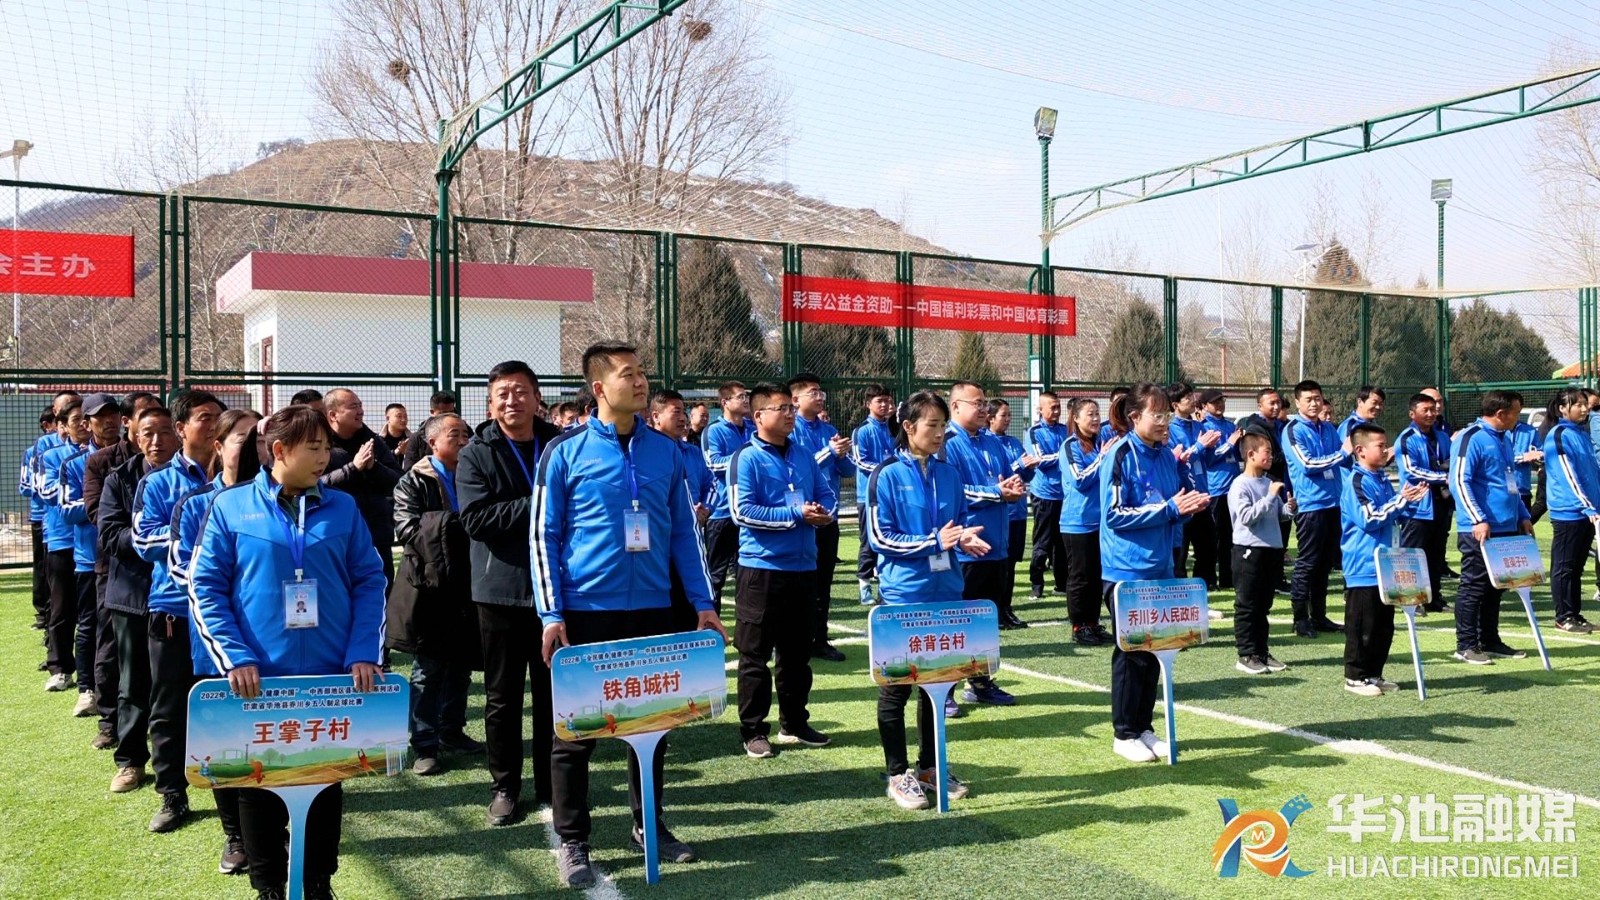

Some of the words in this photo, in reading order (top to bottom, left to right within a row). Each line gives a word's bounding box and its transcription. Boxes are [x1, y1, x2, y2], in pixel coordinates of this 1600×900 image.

[1128, 606, 1200, 626] 乔川乡人民政府
[908, 632, 966, 654] 徐背台村
[603, 671, 681, 701] 铁角城村
[252, 715, 351, 744] 王掌子村
